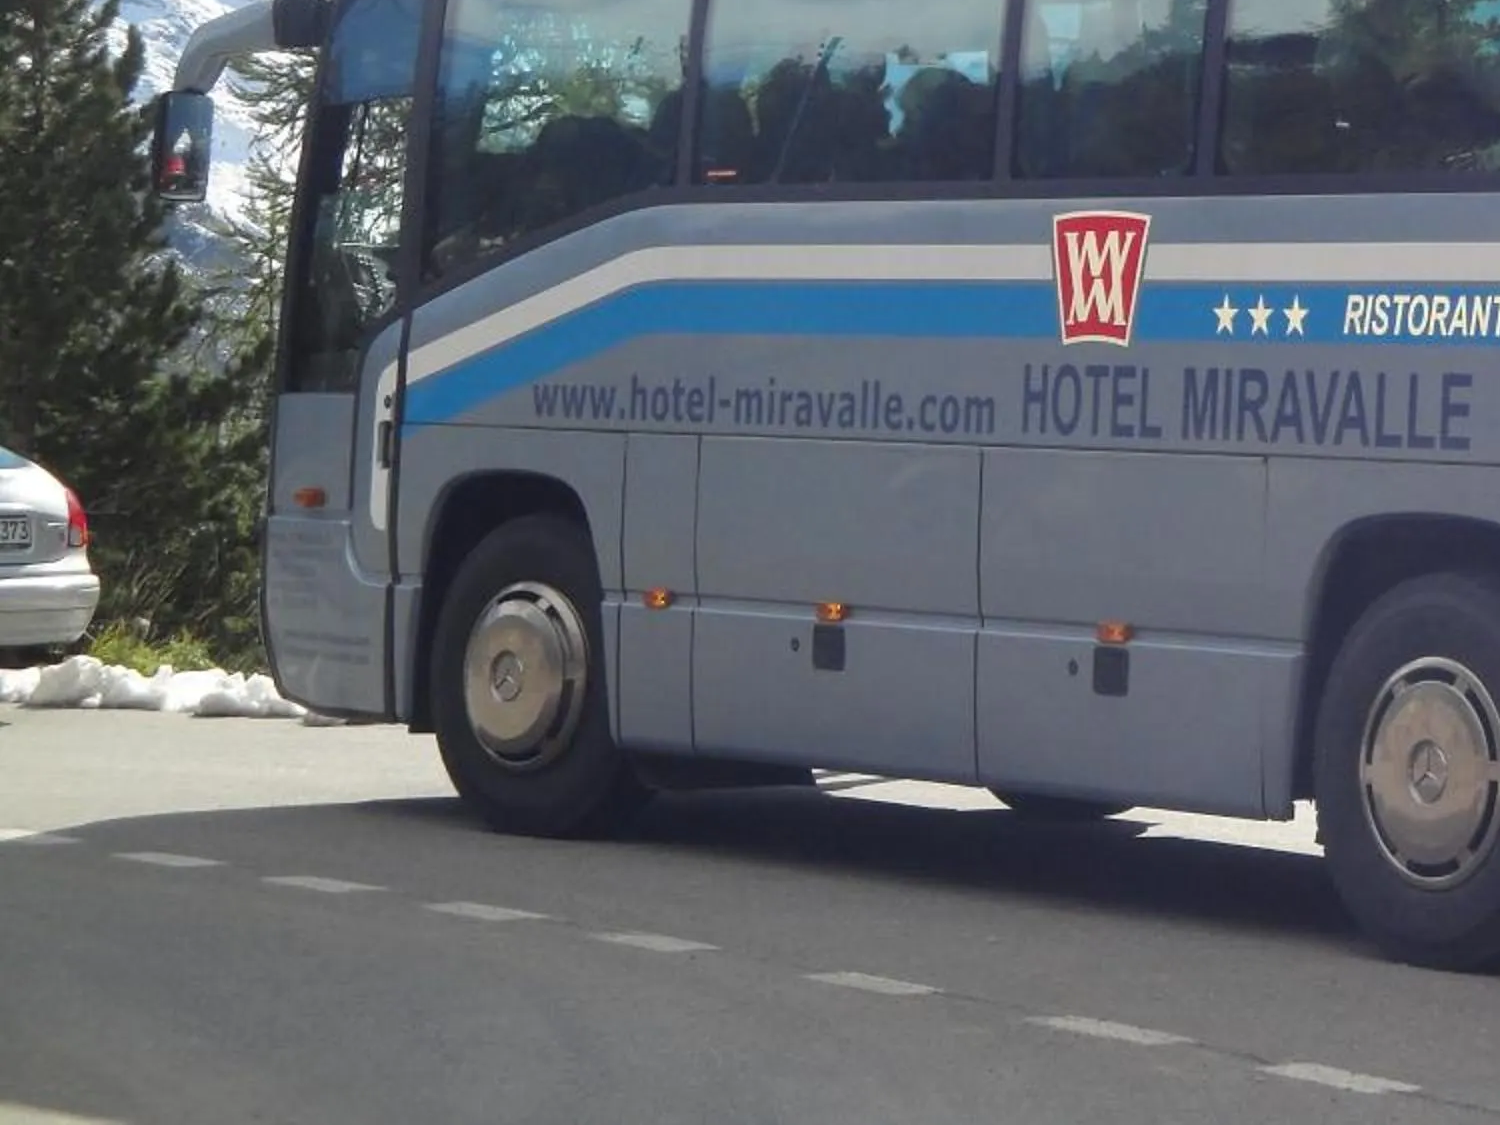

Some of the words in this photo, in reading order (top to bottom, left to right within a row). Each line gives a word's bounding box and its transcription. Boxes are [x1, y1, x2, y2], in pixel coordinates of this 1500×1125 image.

[533, 375, 995, 434] www.hotel-miravalle.com
[1022, 364, 1162, 439] HOTEL
[1181, 367, 1472, 451] MIRAVALLE
